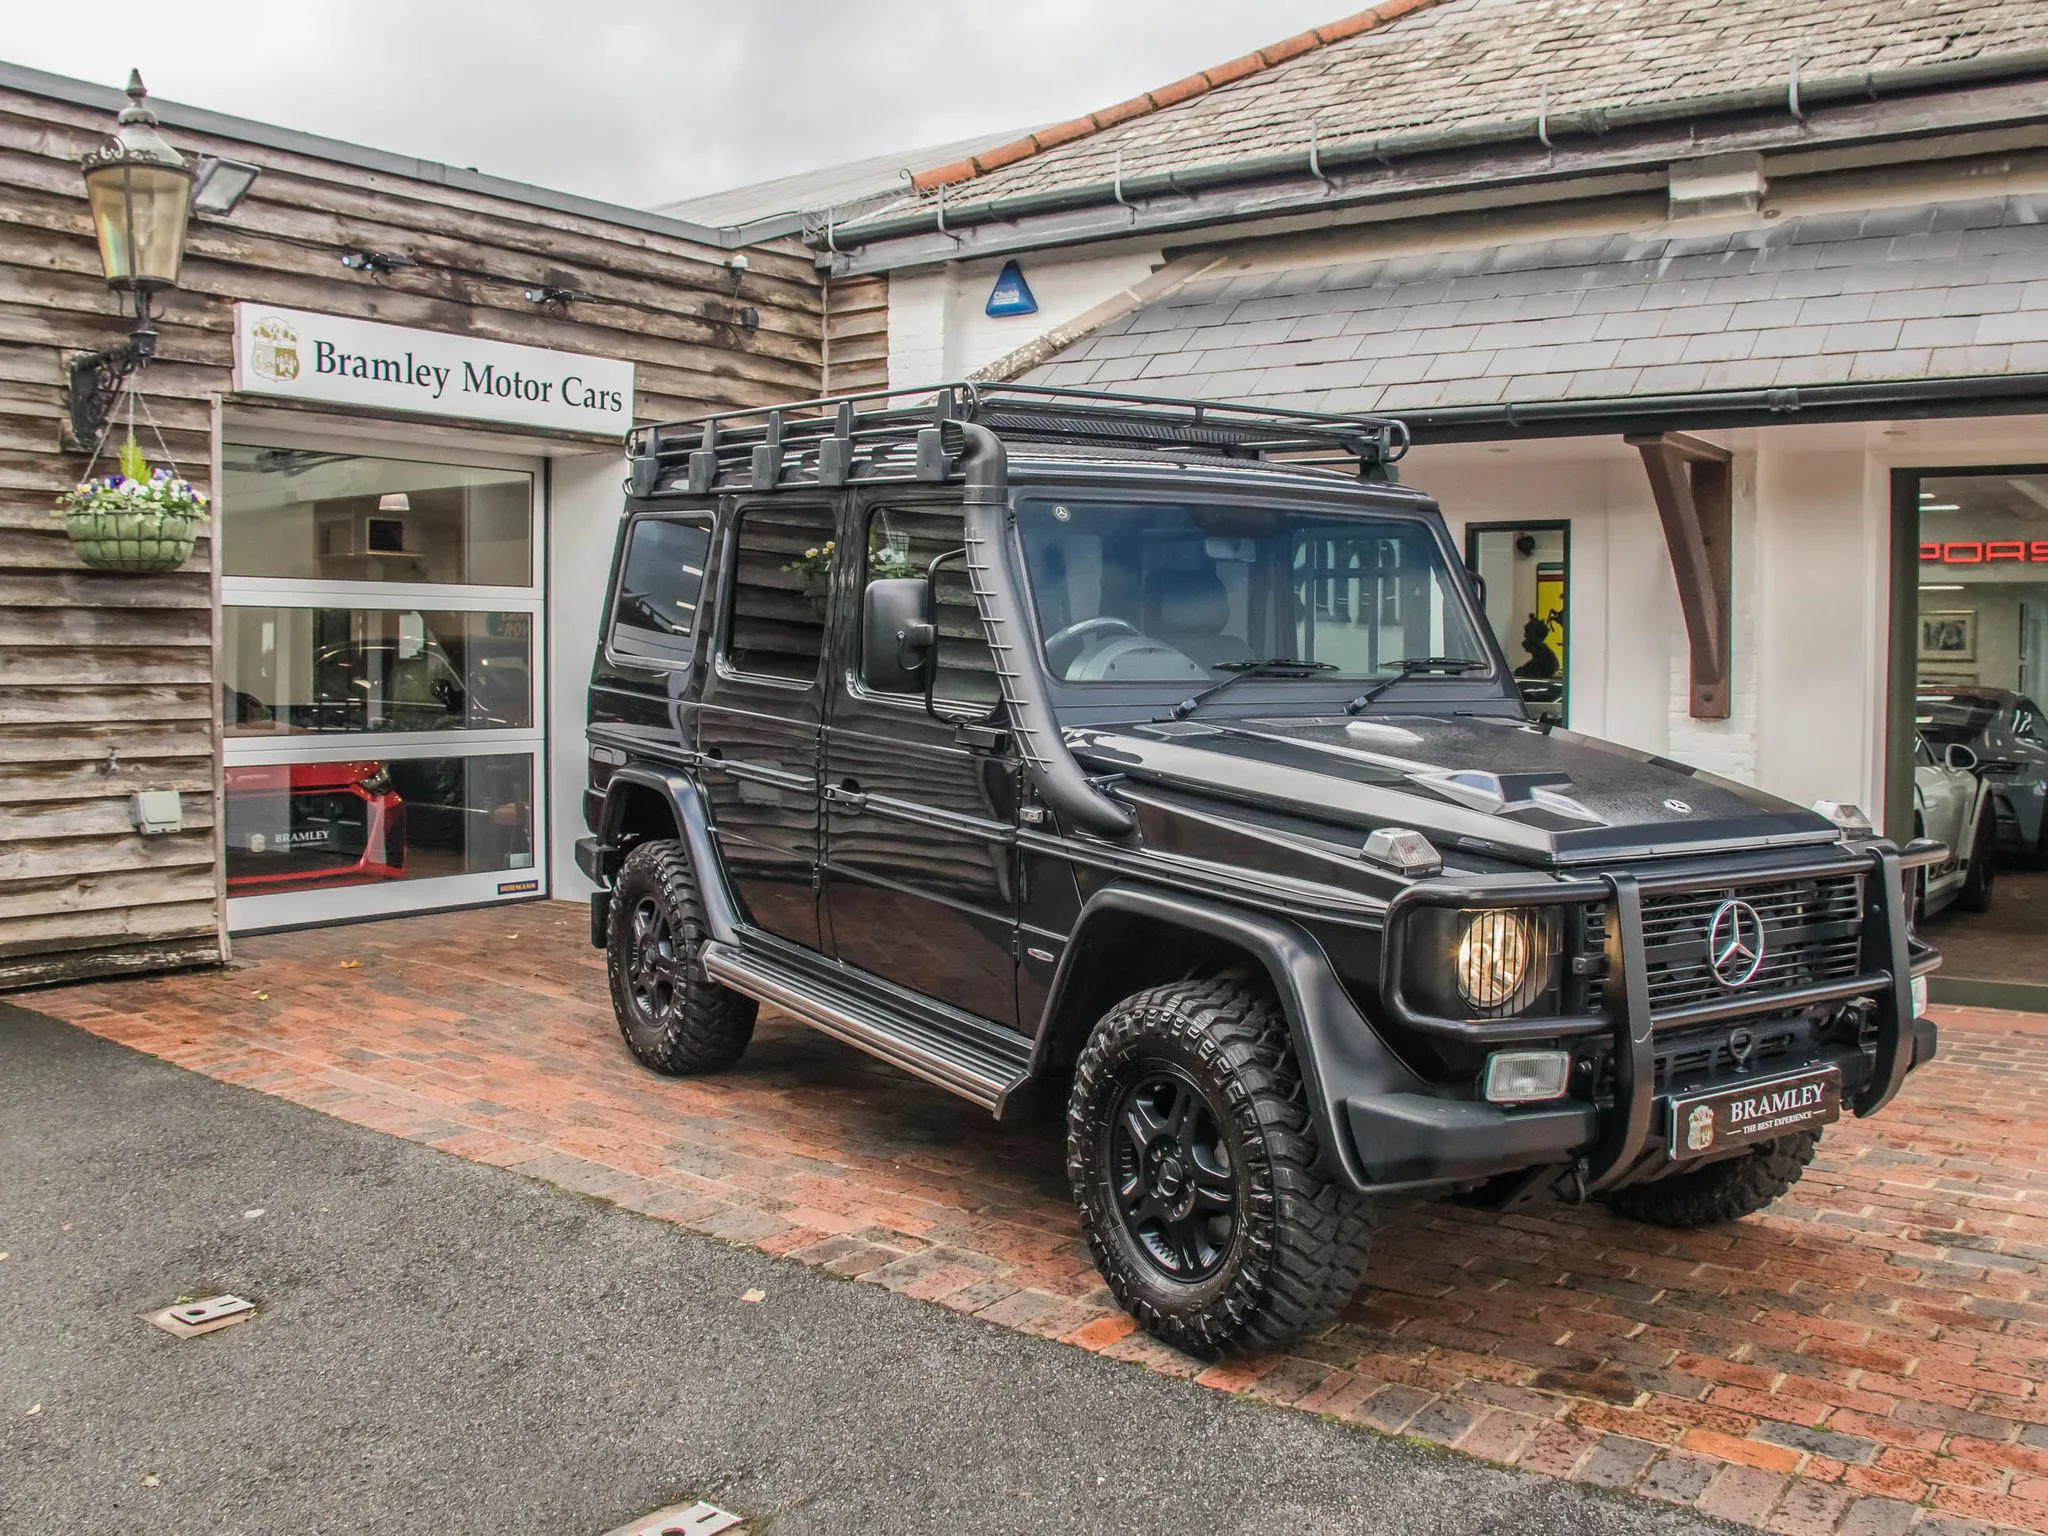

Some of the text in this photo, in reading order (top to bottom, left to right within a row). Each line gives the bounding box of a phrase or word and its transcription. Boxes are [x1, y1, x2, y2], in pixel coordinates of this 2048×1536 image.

[313, 340, 622, 412] Bramley Motor Cars
[275, 830, 330, 843] BRAMLEY
[1730, 1082, 1825, 1123] BRAMLEY
[1743, 1110, 1813, 1134] THE BEST EXPERIENCE
